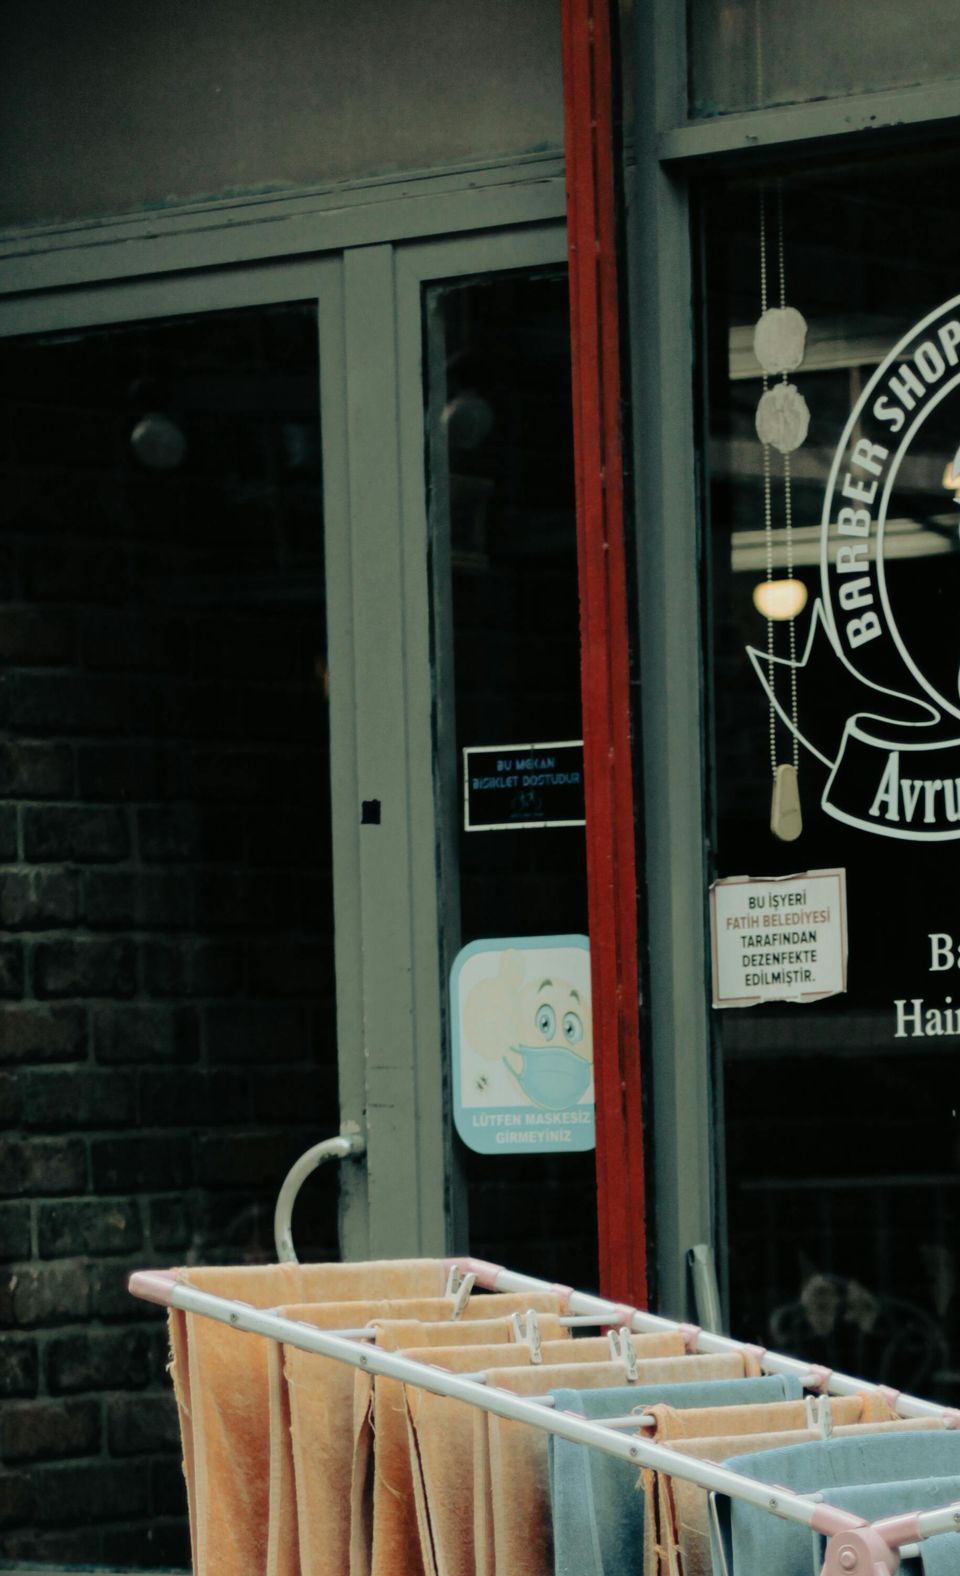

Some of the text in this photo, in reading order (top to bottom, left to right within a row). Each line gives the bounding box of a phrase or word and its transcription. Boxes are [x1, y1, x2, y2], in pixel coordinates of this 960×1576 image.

[835, 437, 889, 649] BARBER
[496, 759, 512, 772] BU
[522, 772, 580, 787] DOSTUDUR
[748, 889, 807, 910] BU İŞYERİ
[725, 906, 831, 930] FATİH BELEDİYESİ
[741, 930, 817, 948] TARAFINDAN
[742, 949, 817, 967] DEZENFEKTE
[745, 967, 816, 988] EDİLMİŞTİR.
[473, 1110, 591, 1127] LÜTFEN MASKESİZ
[495, 1128, 573, 1144] GİRMEYİNİZ
